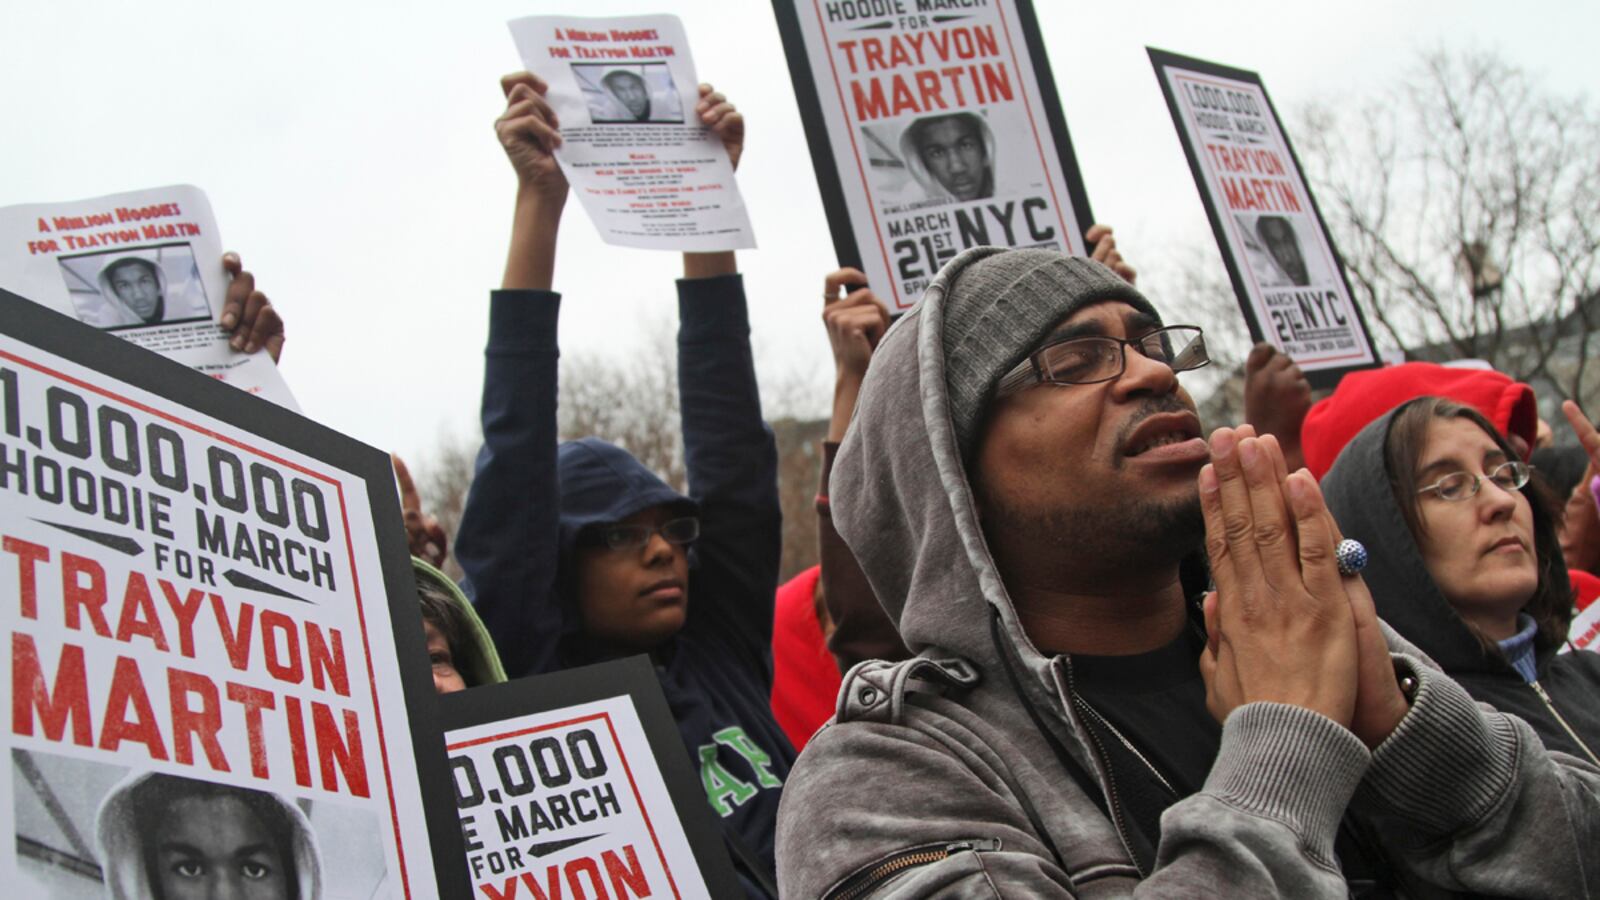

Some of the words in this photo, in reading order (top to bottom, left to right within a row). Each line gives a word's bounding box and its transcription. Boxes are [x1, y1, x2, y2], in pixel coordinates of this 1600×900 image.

[826, 0, 906, 22] HOODIE
[899, 15, 929, 30] FOR
[837, 24, 1000, 74] TRAYVON
[850, 62, 1014, 121] MARTIN
[1206, 143, 1286, 176] TRAYVON
[1220, 175, 1302, 212] MARTIN
[28, 238, 62, 256] FOR
[63, 229, 141, 250] TRAYVON
[141, 223, 201, 240] MARTIN
[887, 212, 951, 239] MARCH
[954, 197, 1055, 249] NYC
[1295, 291, 1347, 329] NYC
[0, 441, 175, 541] HOODIE
[195, 507, 337, 593] MARCH
[154, 541, 217, 588] FOR
[2, 534, 352, 698] TRAYVON
[11, 631, 371, 799] MARTIN
[494, 782, 622, 843] MARCH
[470, 846, 525, 880] FOR
